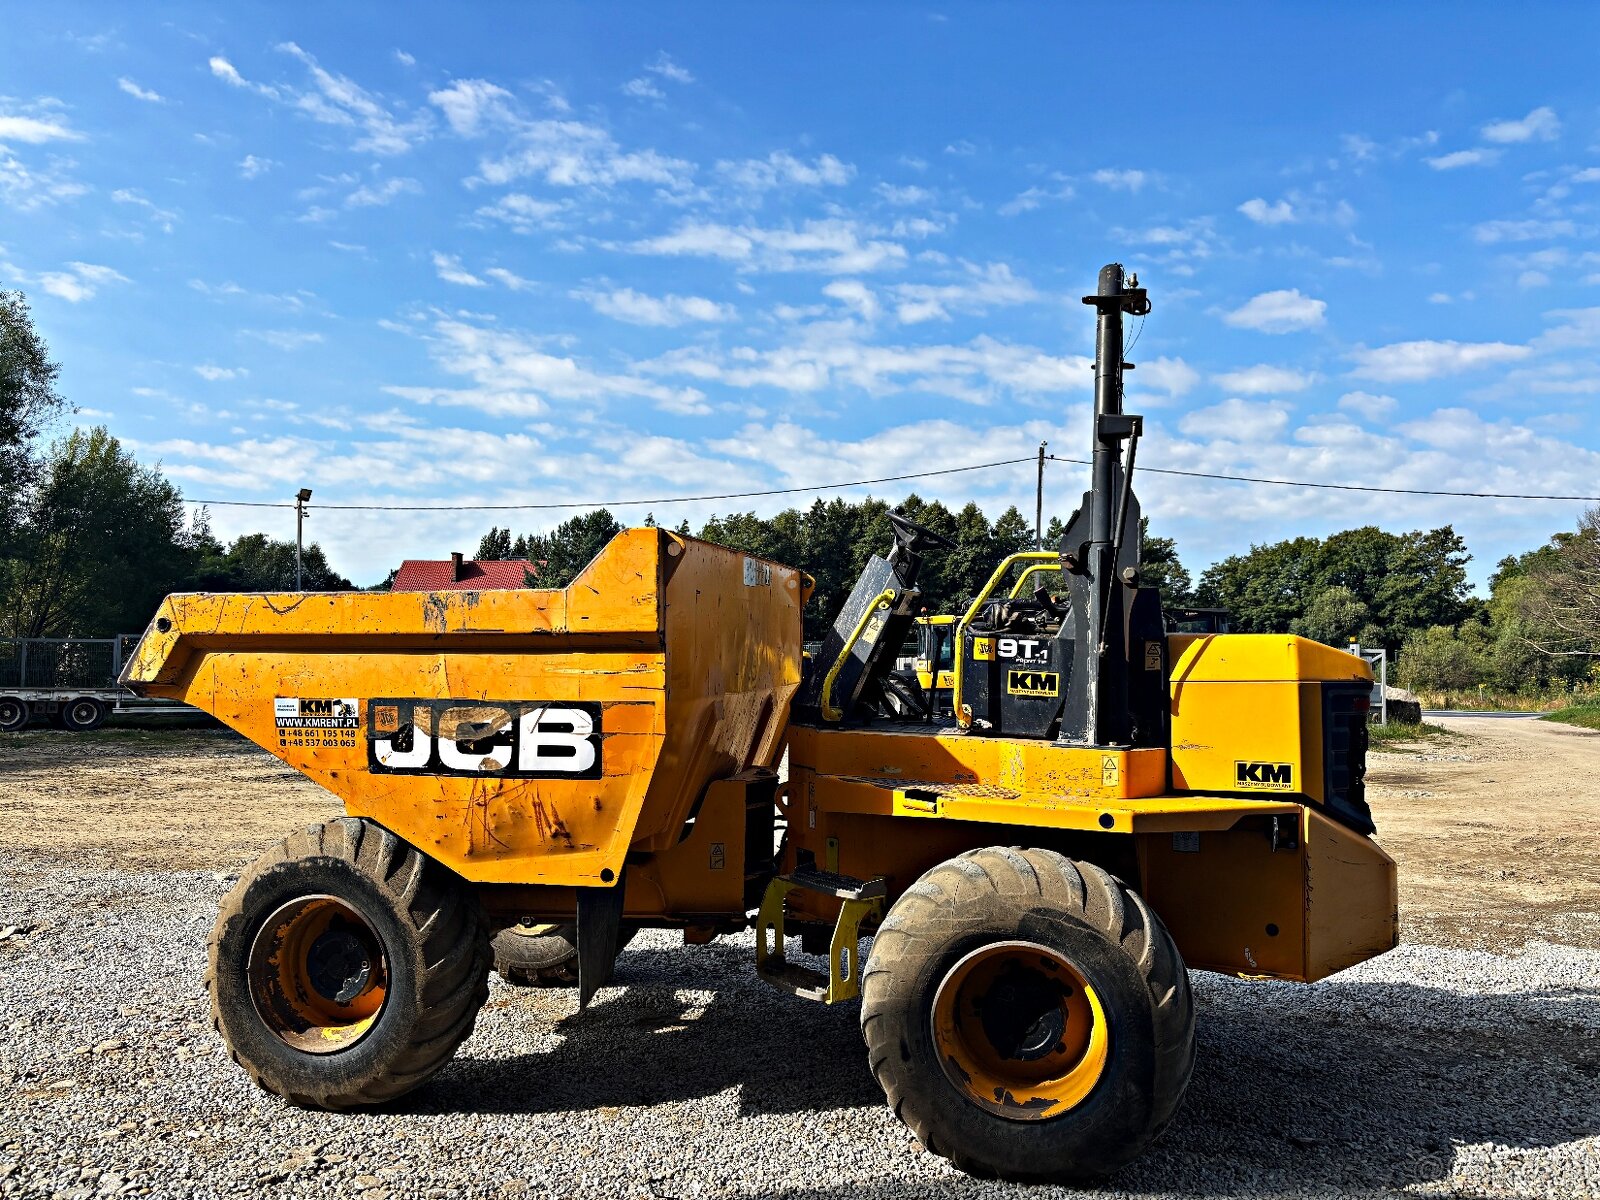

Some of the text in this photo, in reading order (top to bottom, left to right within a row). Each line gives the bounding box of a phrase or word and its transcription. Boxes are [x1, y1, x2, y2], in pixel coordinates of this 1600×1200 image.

[1010, 672, 1057, 691] KM
[300, 700, 332, 713] KM
[276, 717, 358, 728] WWW.KMRENT.PL
[287, 729, 356, 738] +48 661 195 148
[375, 706, 595, 771] JCB
[287, 738, 356, 747] +48 537 003 063
[1237, 763, 1291, 783] KM
